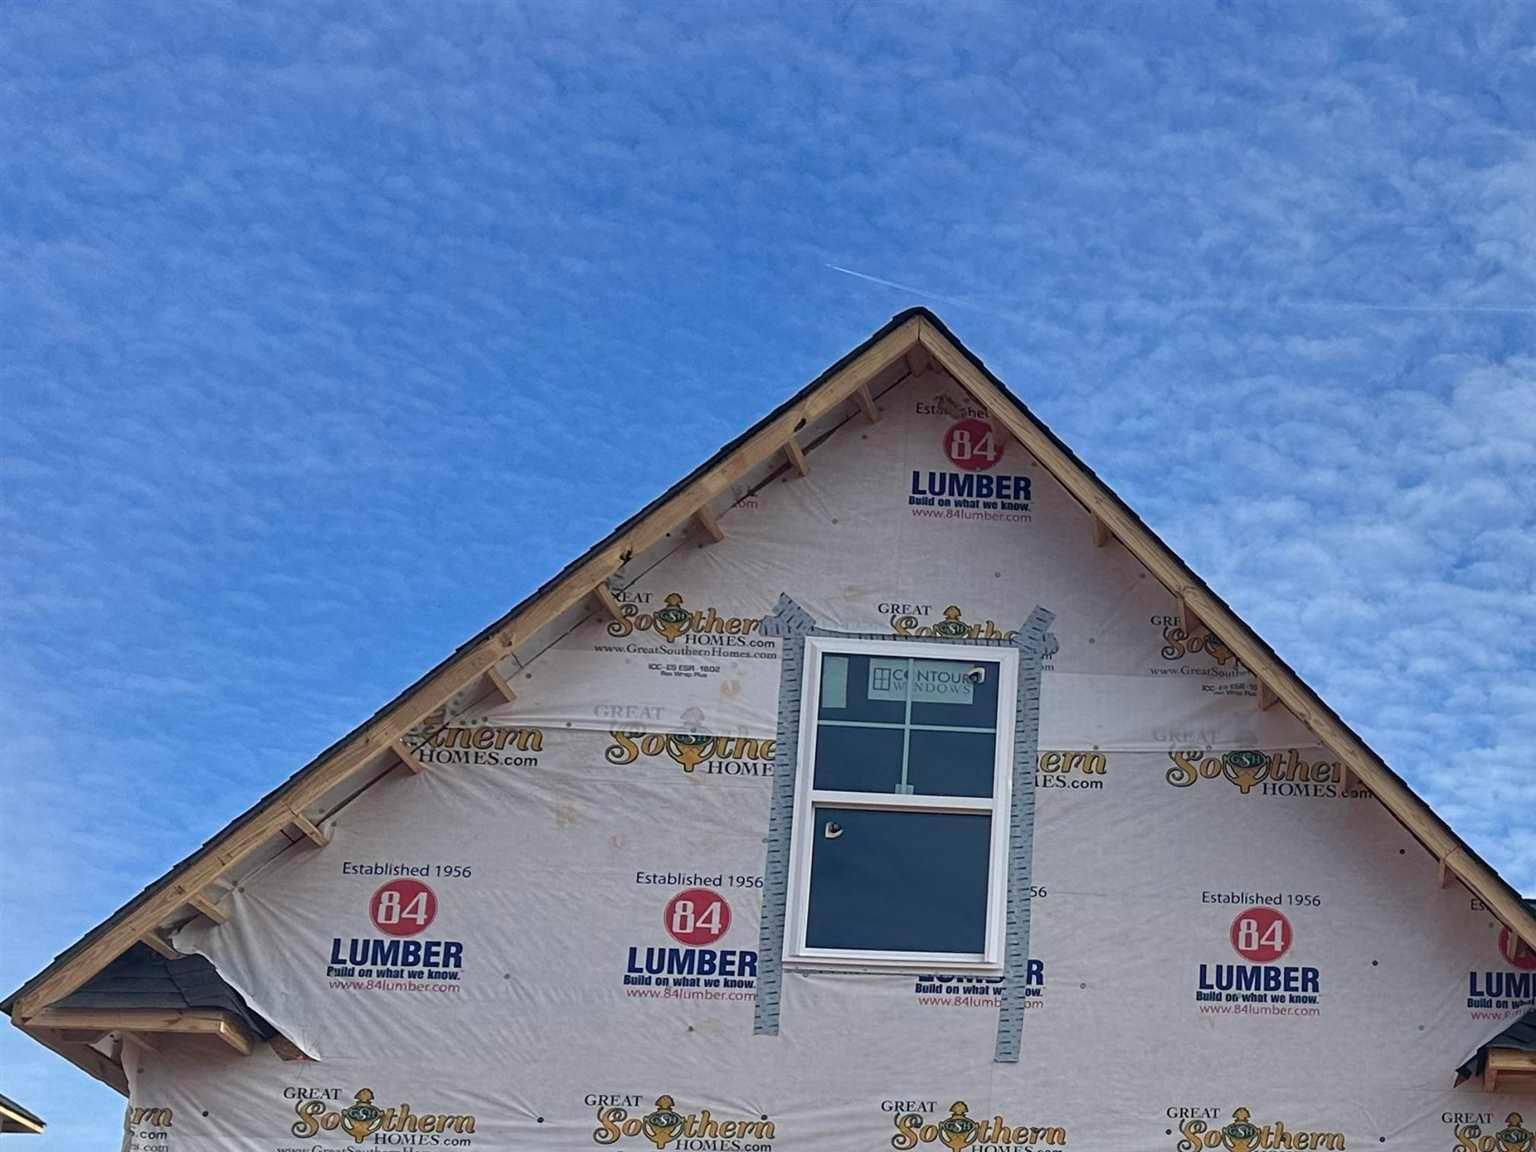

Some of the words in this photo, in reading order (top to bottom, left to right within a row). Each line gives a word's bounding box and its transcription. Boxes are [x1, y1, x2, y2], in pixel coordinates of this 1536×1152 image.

[951, 430, 997, 461] 84
[911, 470, 1032, 501] LUMBER
[912, 508, 1032, 522] www.84lumber.com
[878, 603, 932, 616] GREAT
[684, 634, 775, 649] HOMES.com
[418, 750, 538, 766] HOMES.com
[342, 862, 430, 877] Established
[435, 865, 472, 878] 1956
[636, 871, 722, 886] Established
[728, 875, 764, 889] 1956
[1201, 891, 1282, 905] Established
[1287, 894, 1321, 907] 1956
[376, 891, 429, 925] 84
[672, 900, 722, 935] 84
[1238, 918, 1285, 952] 84
[330, 938, 463, 968] LUMBER
[627, 947, 758, 977] LUMBER
[327, 966, 355, 977] Build
[358, 968, 373, 978] on
[375, 968, 405, 978] what
[407, 971, 425, 980] we
[427, 970, 461, 981] know.
[1198, 964, 1320, 993] LUMBER
[328, 979, 460, 993] www.84lumber.com
[623, 974, 650, 985] Build
[655, 977, 669, 987] on
[672, 976, 700, 988] what
[704, 979, 720, 988] we
[723, 978, 756, 990] know.
[915, 983, 942, 995] Build
[946, 985, 959, 995] on
[963, 984, 990, 996] what
[626, 987, 758, 1001] www.84lumber.com
[1196, 991, 1222, 1002] Build
[1225, 993, 1239, 1003] on
[1241, 992, 1267, 1003] what
[1270, 994, 1286, 1003] we
[1289, 993, 1320, 1004] know.
[1199, 1004, 1321, 1017] www.84lumber.com
[283, 1087, 343, 1100] GREAT
[585, 1094, 643, 1106] GREAT
[881, 1101, 938, 1112] GREAT
[1166, 1107, 1221, 1119] GREAT
[1441, 1112, 1493, 1124] GREAT
[374, 1132, 472, 1147] HOMES.com
[675, 1139, 772, 1152] HOMES.com
